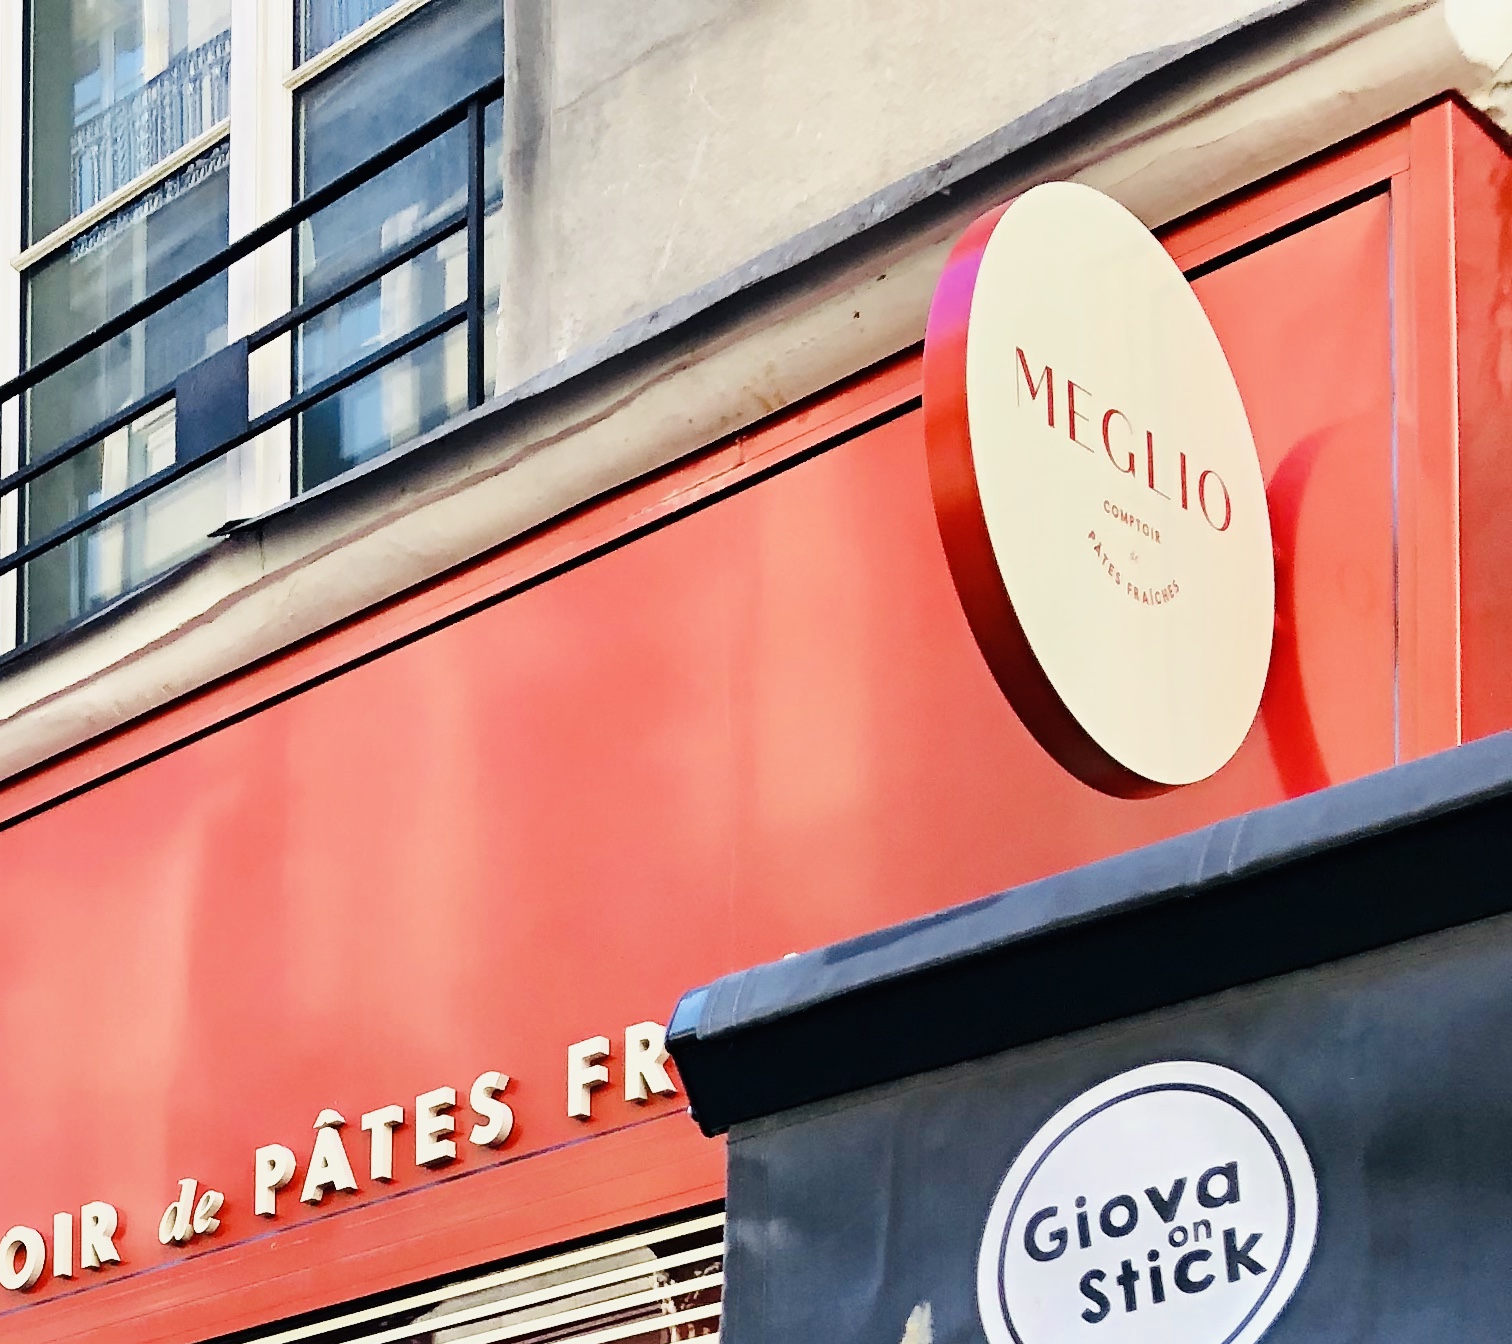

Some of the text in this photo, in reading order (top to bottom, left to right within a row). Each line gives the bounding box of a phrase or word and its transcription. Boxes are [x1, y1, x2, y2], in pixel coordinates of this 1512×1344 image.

[1016, 346, 1231, 531] MEGLIO
[1103, 499, 1161, 544] COMPTOIR
[158, 1178, 224, 1246] de
[254, 1070, 514, 1215] PÂTES
[1023, 1161, 1241, 1262] Giova
[1168, 1219, 1212, 1248] on
[1079, 1227, 1268, 1324] Stick
